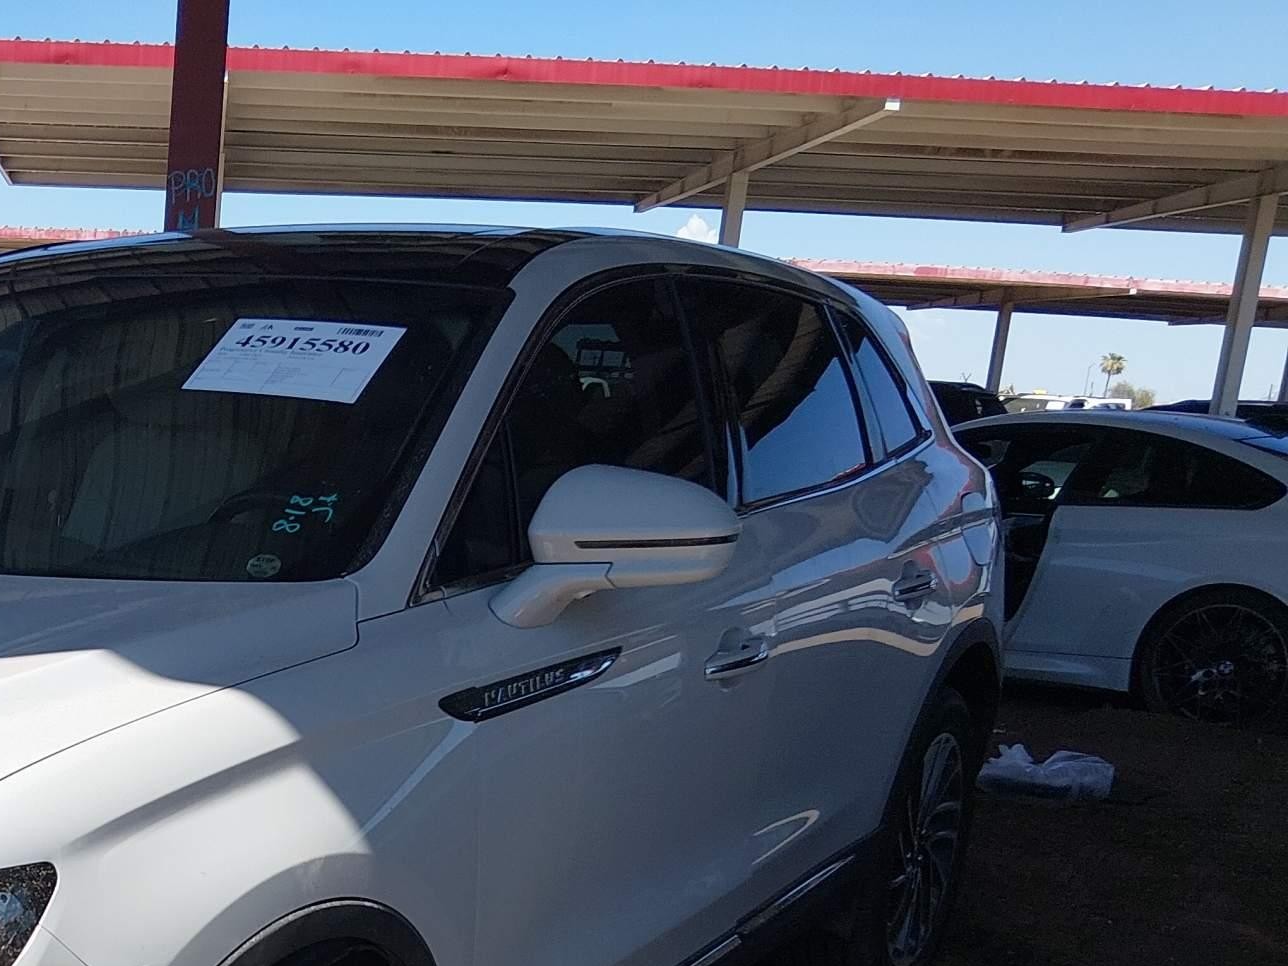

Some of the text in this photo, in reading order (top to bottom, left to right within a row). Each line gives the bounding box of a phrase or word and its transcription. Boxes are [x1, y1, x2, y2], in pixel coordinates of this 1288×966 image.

[168, 168, 216, 204] PRO
[235, 335, 370, 355] 45915580
[484, 668, 565, 708] NAUTILUS
